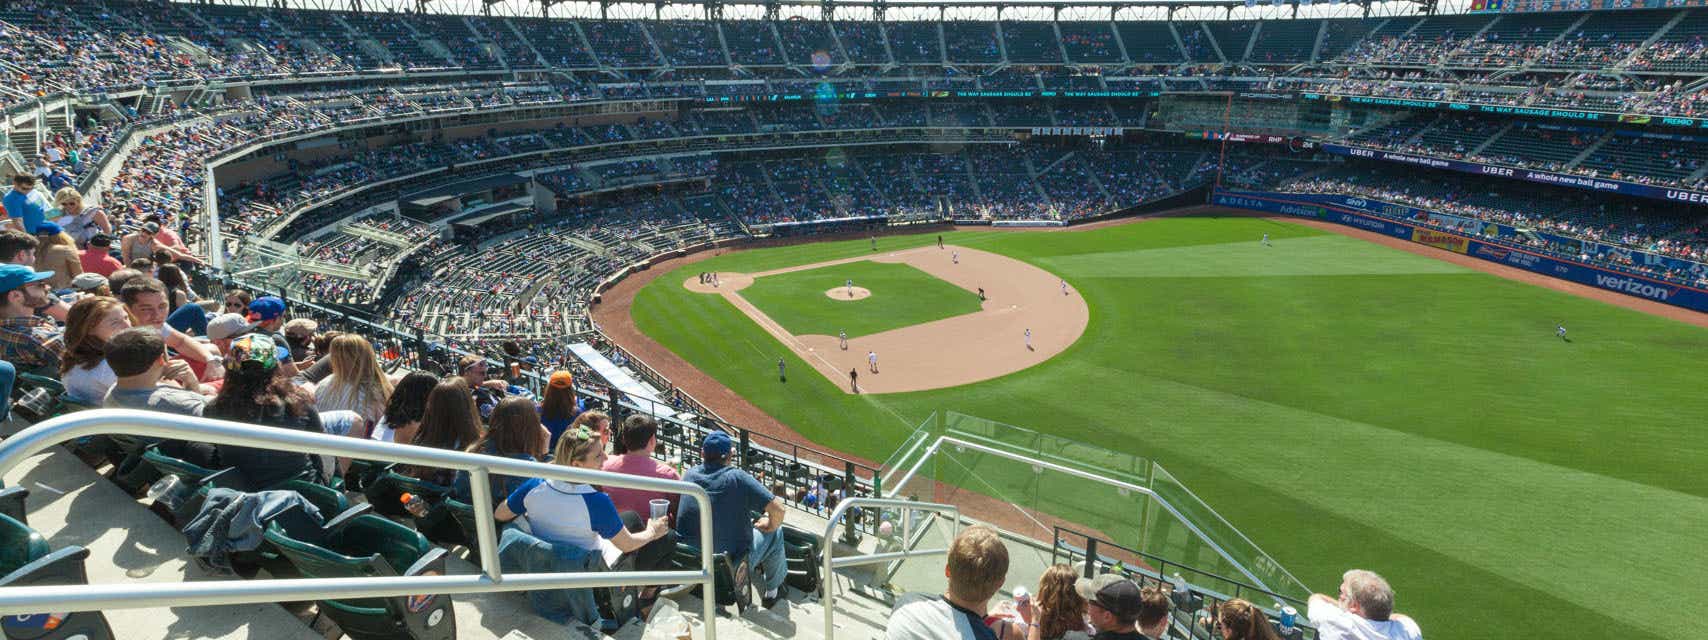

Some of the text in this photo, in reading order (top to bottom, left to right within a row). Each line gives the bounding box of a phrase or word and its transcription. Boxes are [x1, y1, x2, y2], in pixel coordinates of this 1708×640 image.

[1514, 108, 1549, 116] SAUSAGE
[1552, 110, 1585, 119] SHOULD
[1350, 148, 1374, 158] UBER
[1389, 153, 1406, 161] whole
[1419, 157, 1431, 165] ball
[1431, 159, 1449, 167] game
[1482, 165, 1619, 190] UBER A whole new ball game
[1230, 197, 1263, 208] DELTA
[1666, 190, 1708, 204] UBER
[1353, 215, 1385, 229] HYUNDAI
[1596, 274, 1668, 300] verizon
